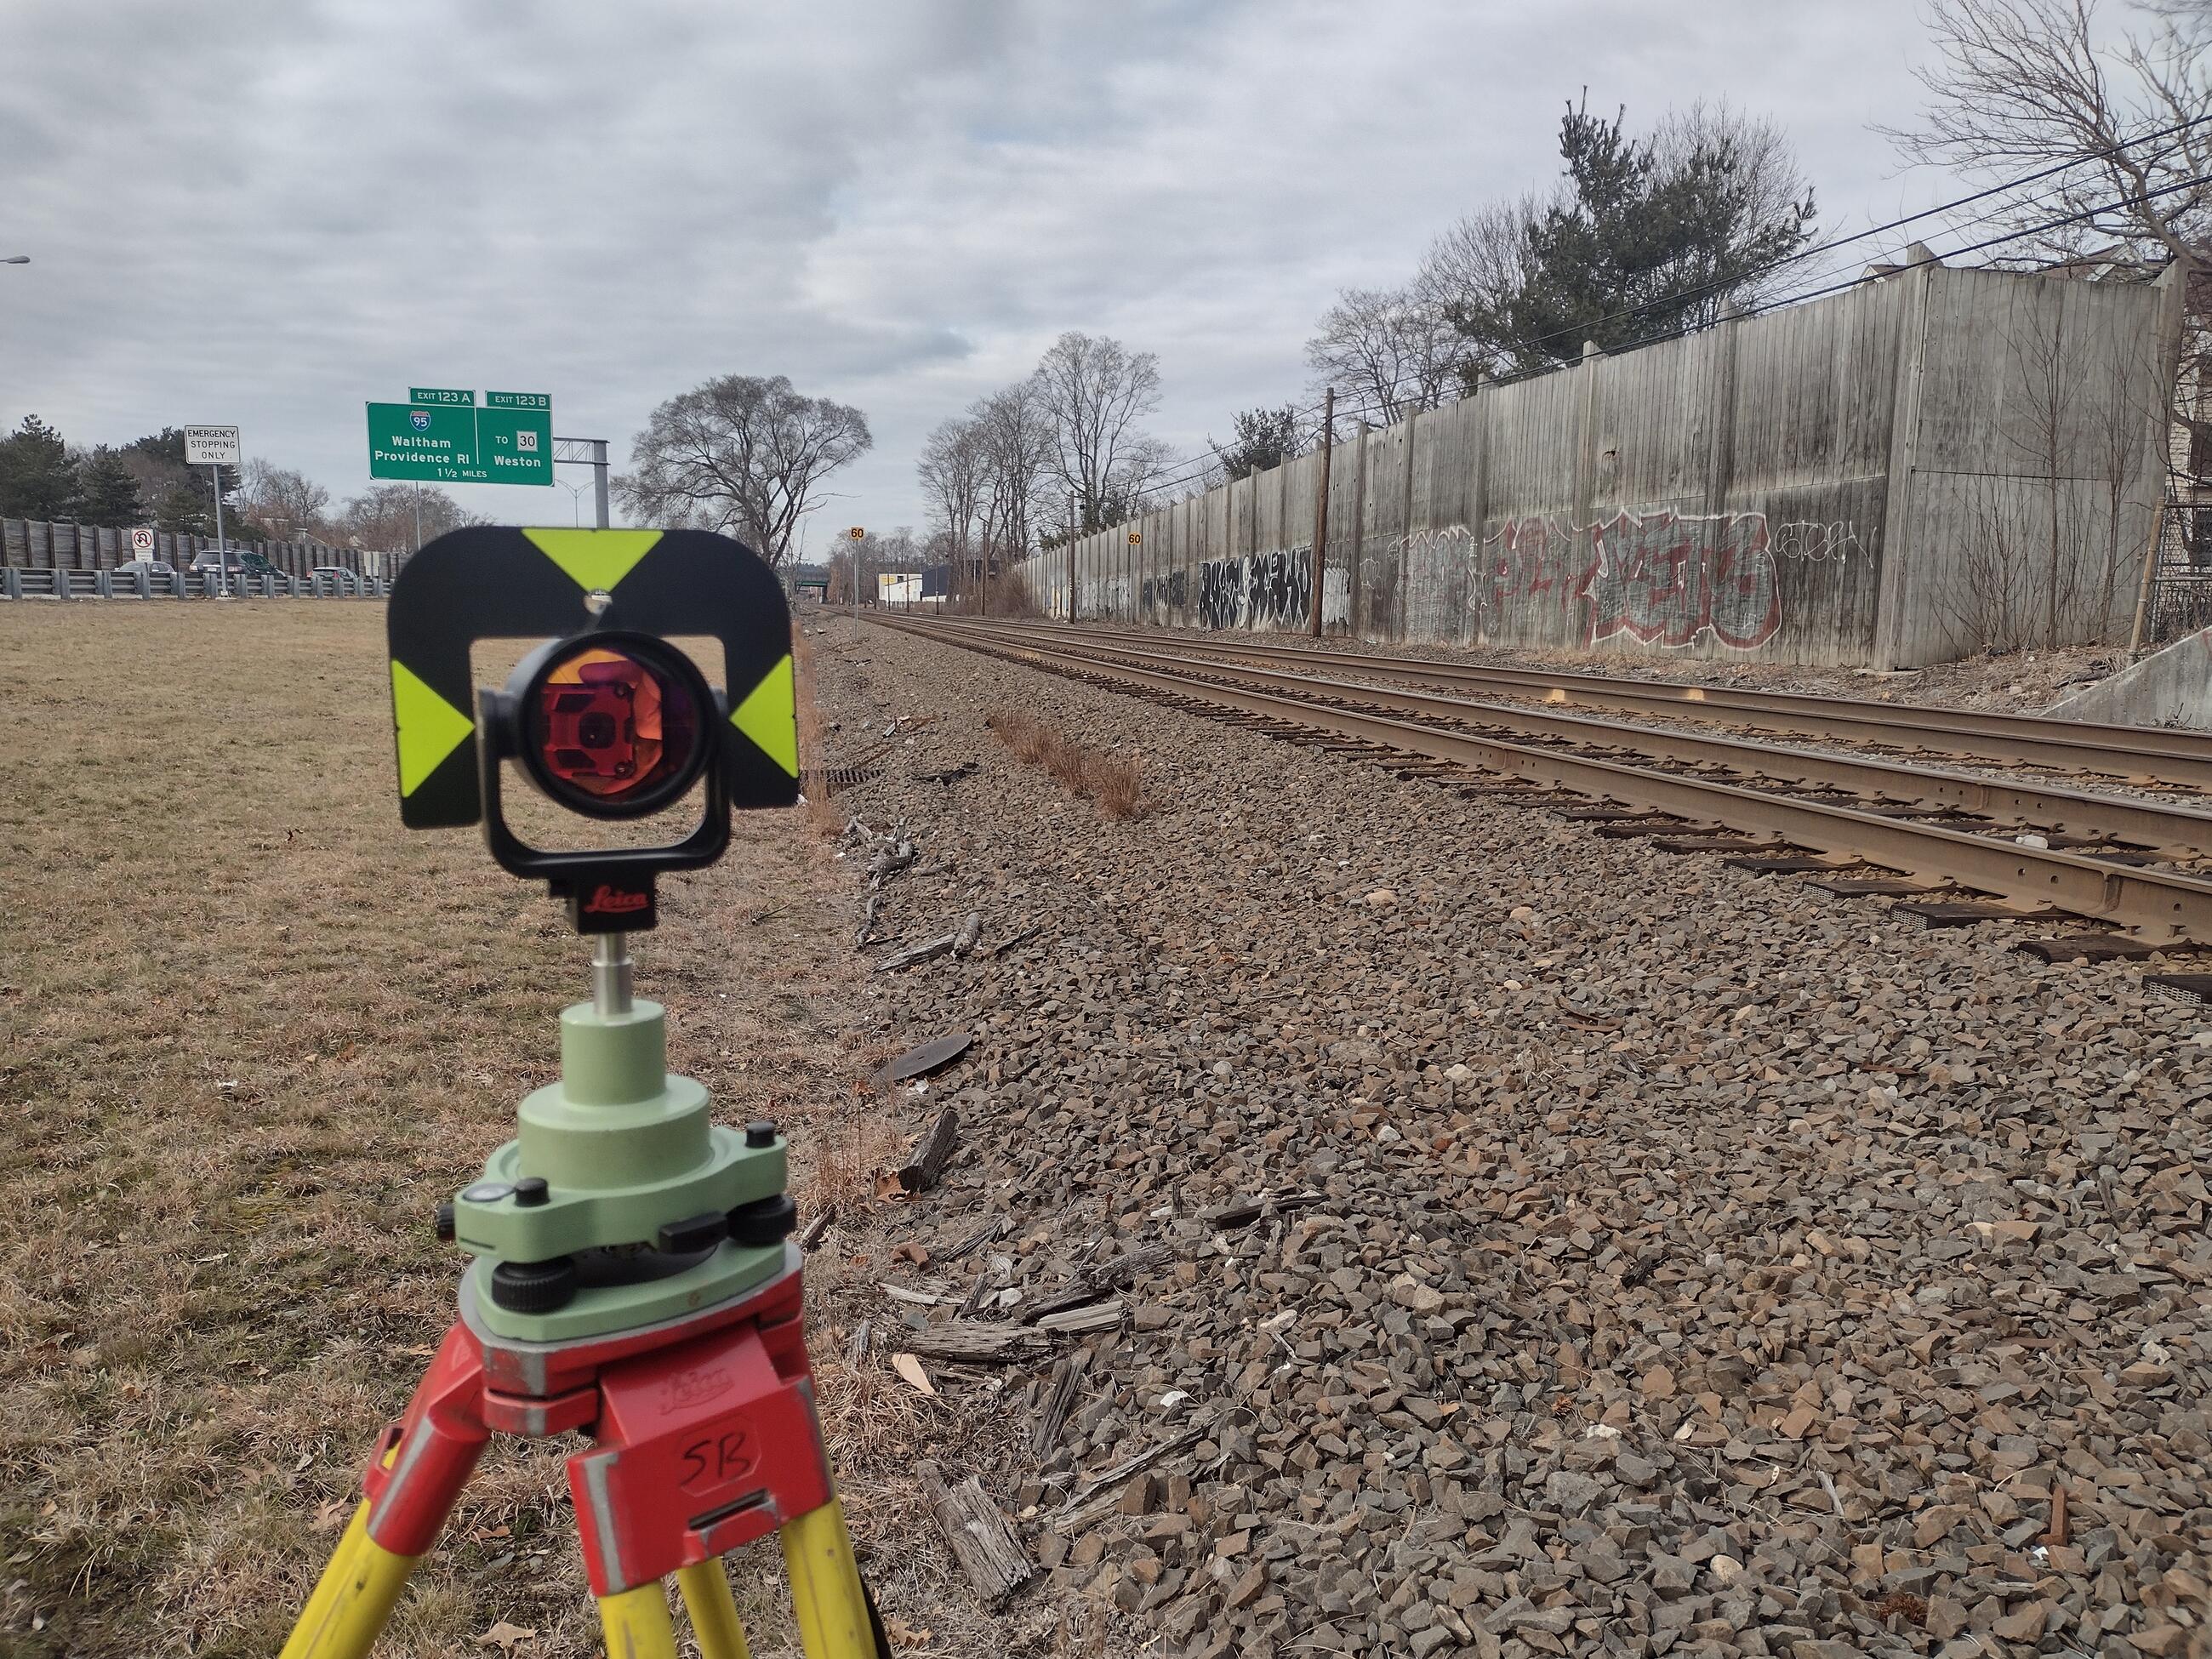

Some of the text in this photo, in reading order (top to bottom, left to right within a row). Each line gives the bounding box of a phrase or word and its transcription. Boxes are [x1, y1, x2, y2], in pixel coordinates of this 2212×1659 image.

[438, 392, 459, 402] 123
[461, 393, 471, 403] A
[516, 396, 536, 406] 123
[539, 396, 546, 407] B
[413, 416, 428, 427] 95
[187, 429, 236, 438] EMERGENCY
[191, 440, 236, 448] STOPPING
[391, 436, 451, 448] Waltham
[495, 435, 535, 447] TO 30
[202, 451, 225, 459] ONLY
[374, 450, 470, 465] Providence RI
[494, 455, 541, 468] Weston
[462, 470, 487, 478] MILES
[851, 528, 864, 538] 60
[1128, 533, 1141, 544] 60
[584, 885, 649, 914] Leica
[680, 1431, 750, 1488] SB
